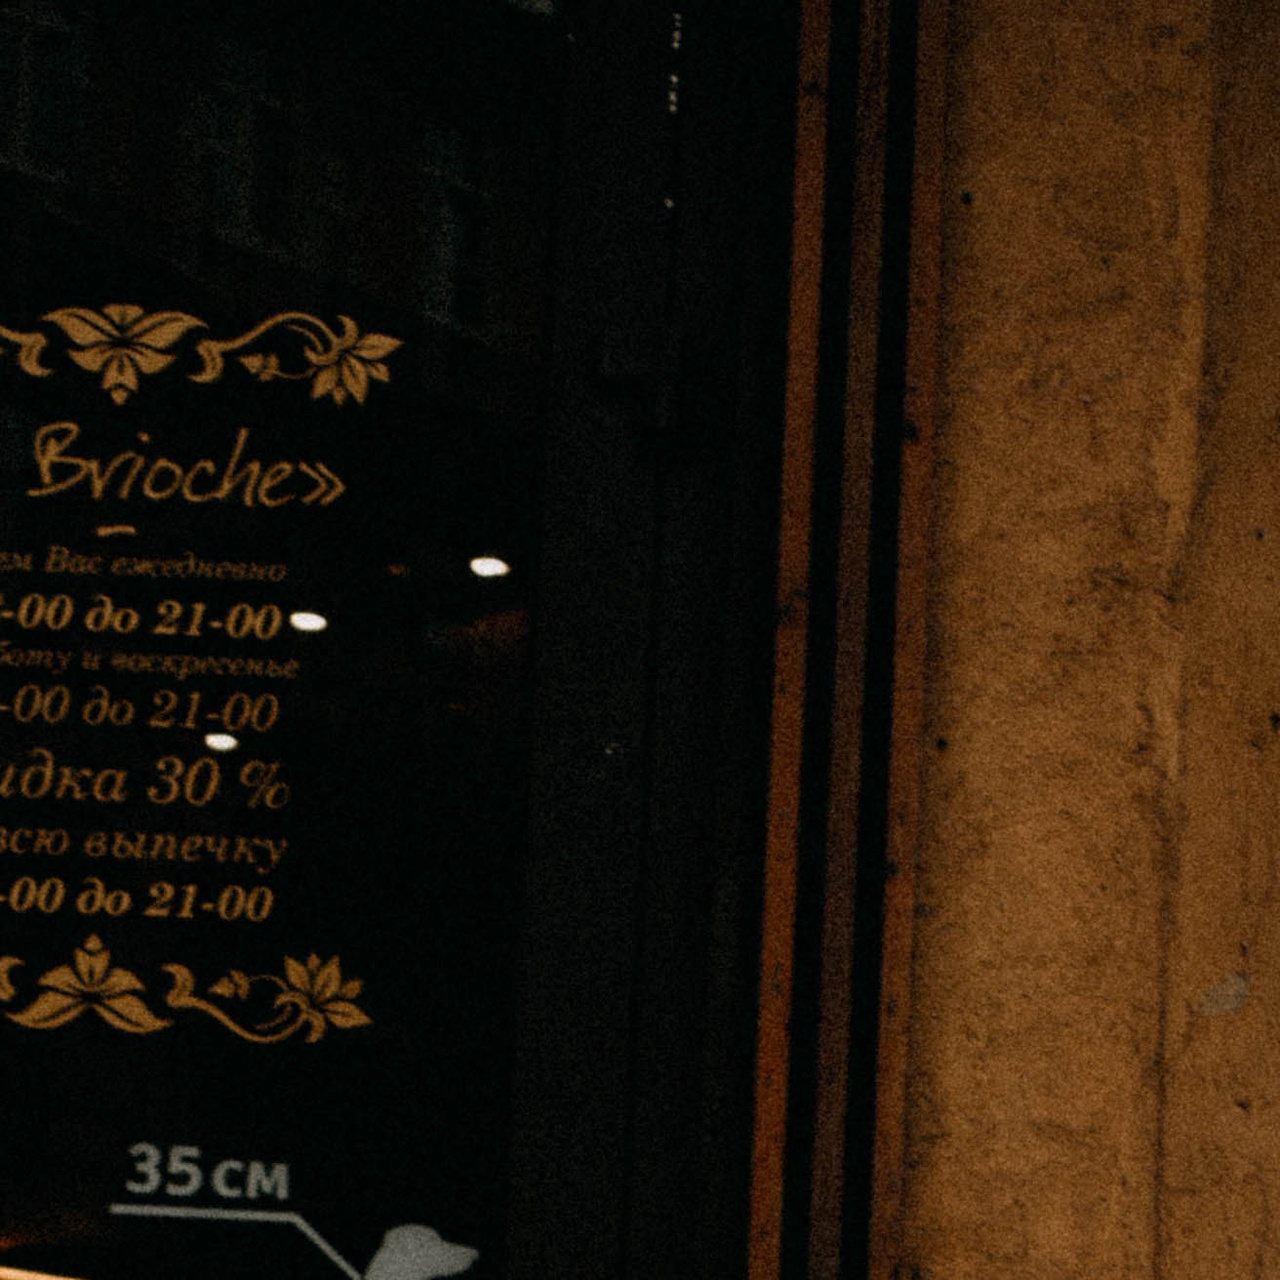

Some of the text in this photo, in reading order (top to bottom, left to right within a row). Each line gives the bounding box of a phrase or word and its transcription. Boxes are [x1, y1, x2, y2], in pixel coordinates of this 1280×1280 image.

[24, 420, 347, 509] Brioche»
[45, 543, 107, 577] Вас
[109, 548, 290, 584] ежедневно
[83, 592, 141, 635] до
[151, 598, 284, 642] 21-00
[80, 648, 101, 672] и
[108, 648, 302, 682] воскресенье
[80, 682, 137, 728] до
[146, 687, 281, 734] 21-00
[145, 753, 221, 808] 30
[82, 827, 291, 876] выпечку
[75, 875, 133, 918] до
[142, 878, 276, 924] 21-00
